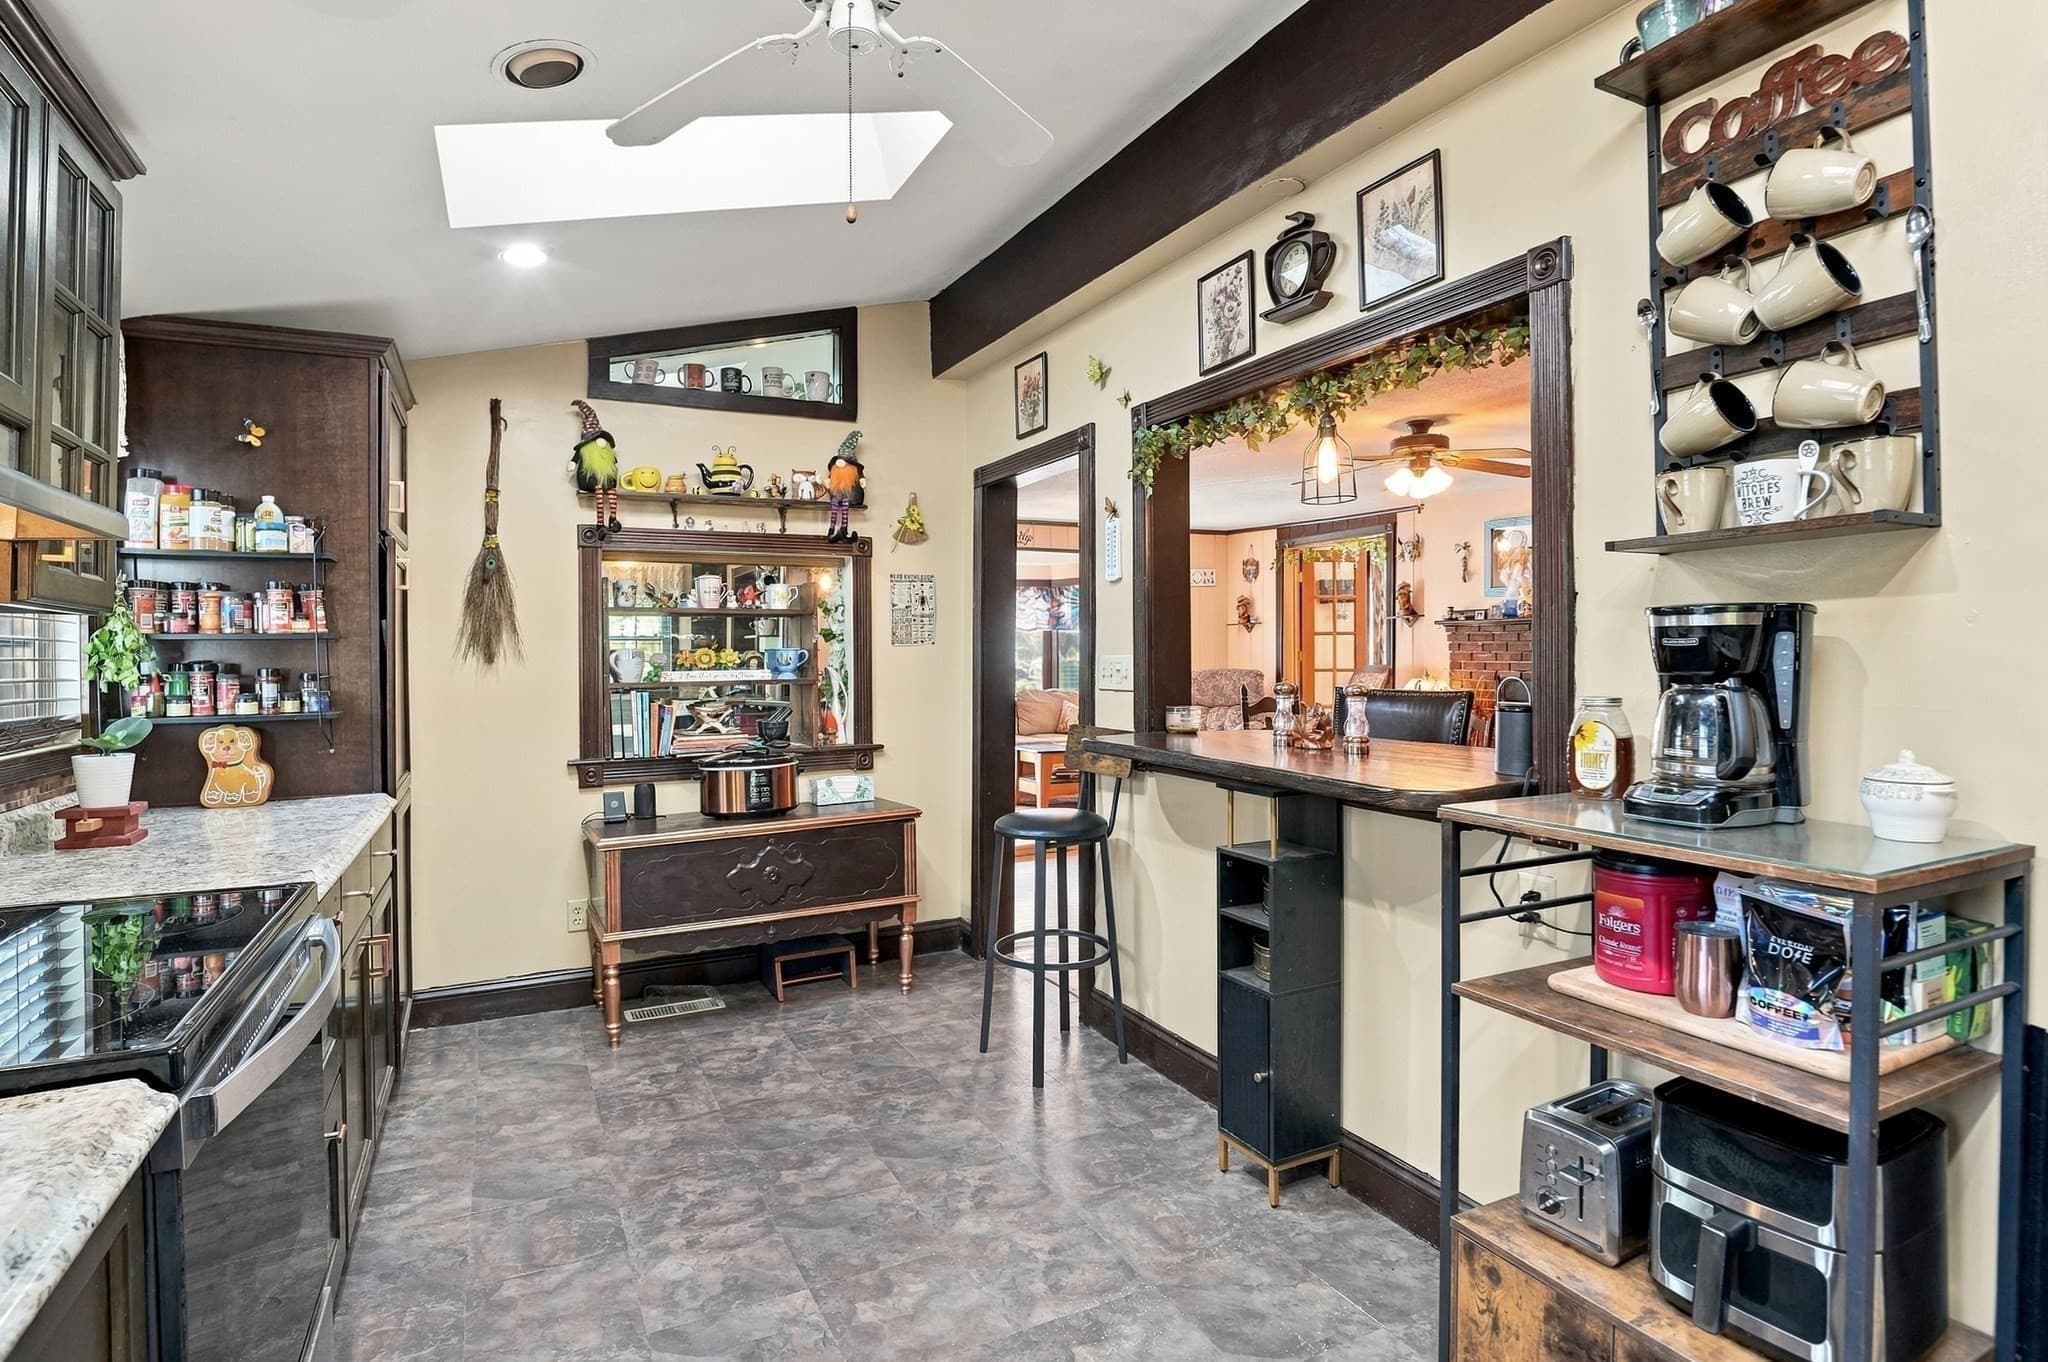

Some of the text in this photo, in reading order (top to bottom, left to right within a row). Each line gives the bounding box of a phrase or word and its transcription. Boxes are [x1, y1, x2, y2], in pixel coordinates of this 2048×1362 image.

[1662, 30, 1911, 167] Coffee
[1736, 481, 1781, 498] WITCHES
[1741, 495, 1772, 510] BREW
[1580, 752, 1610, 770] HONEY
[1598, 911, 1642, 934] Folgers
